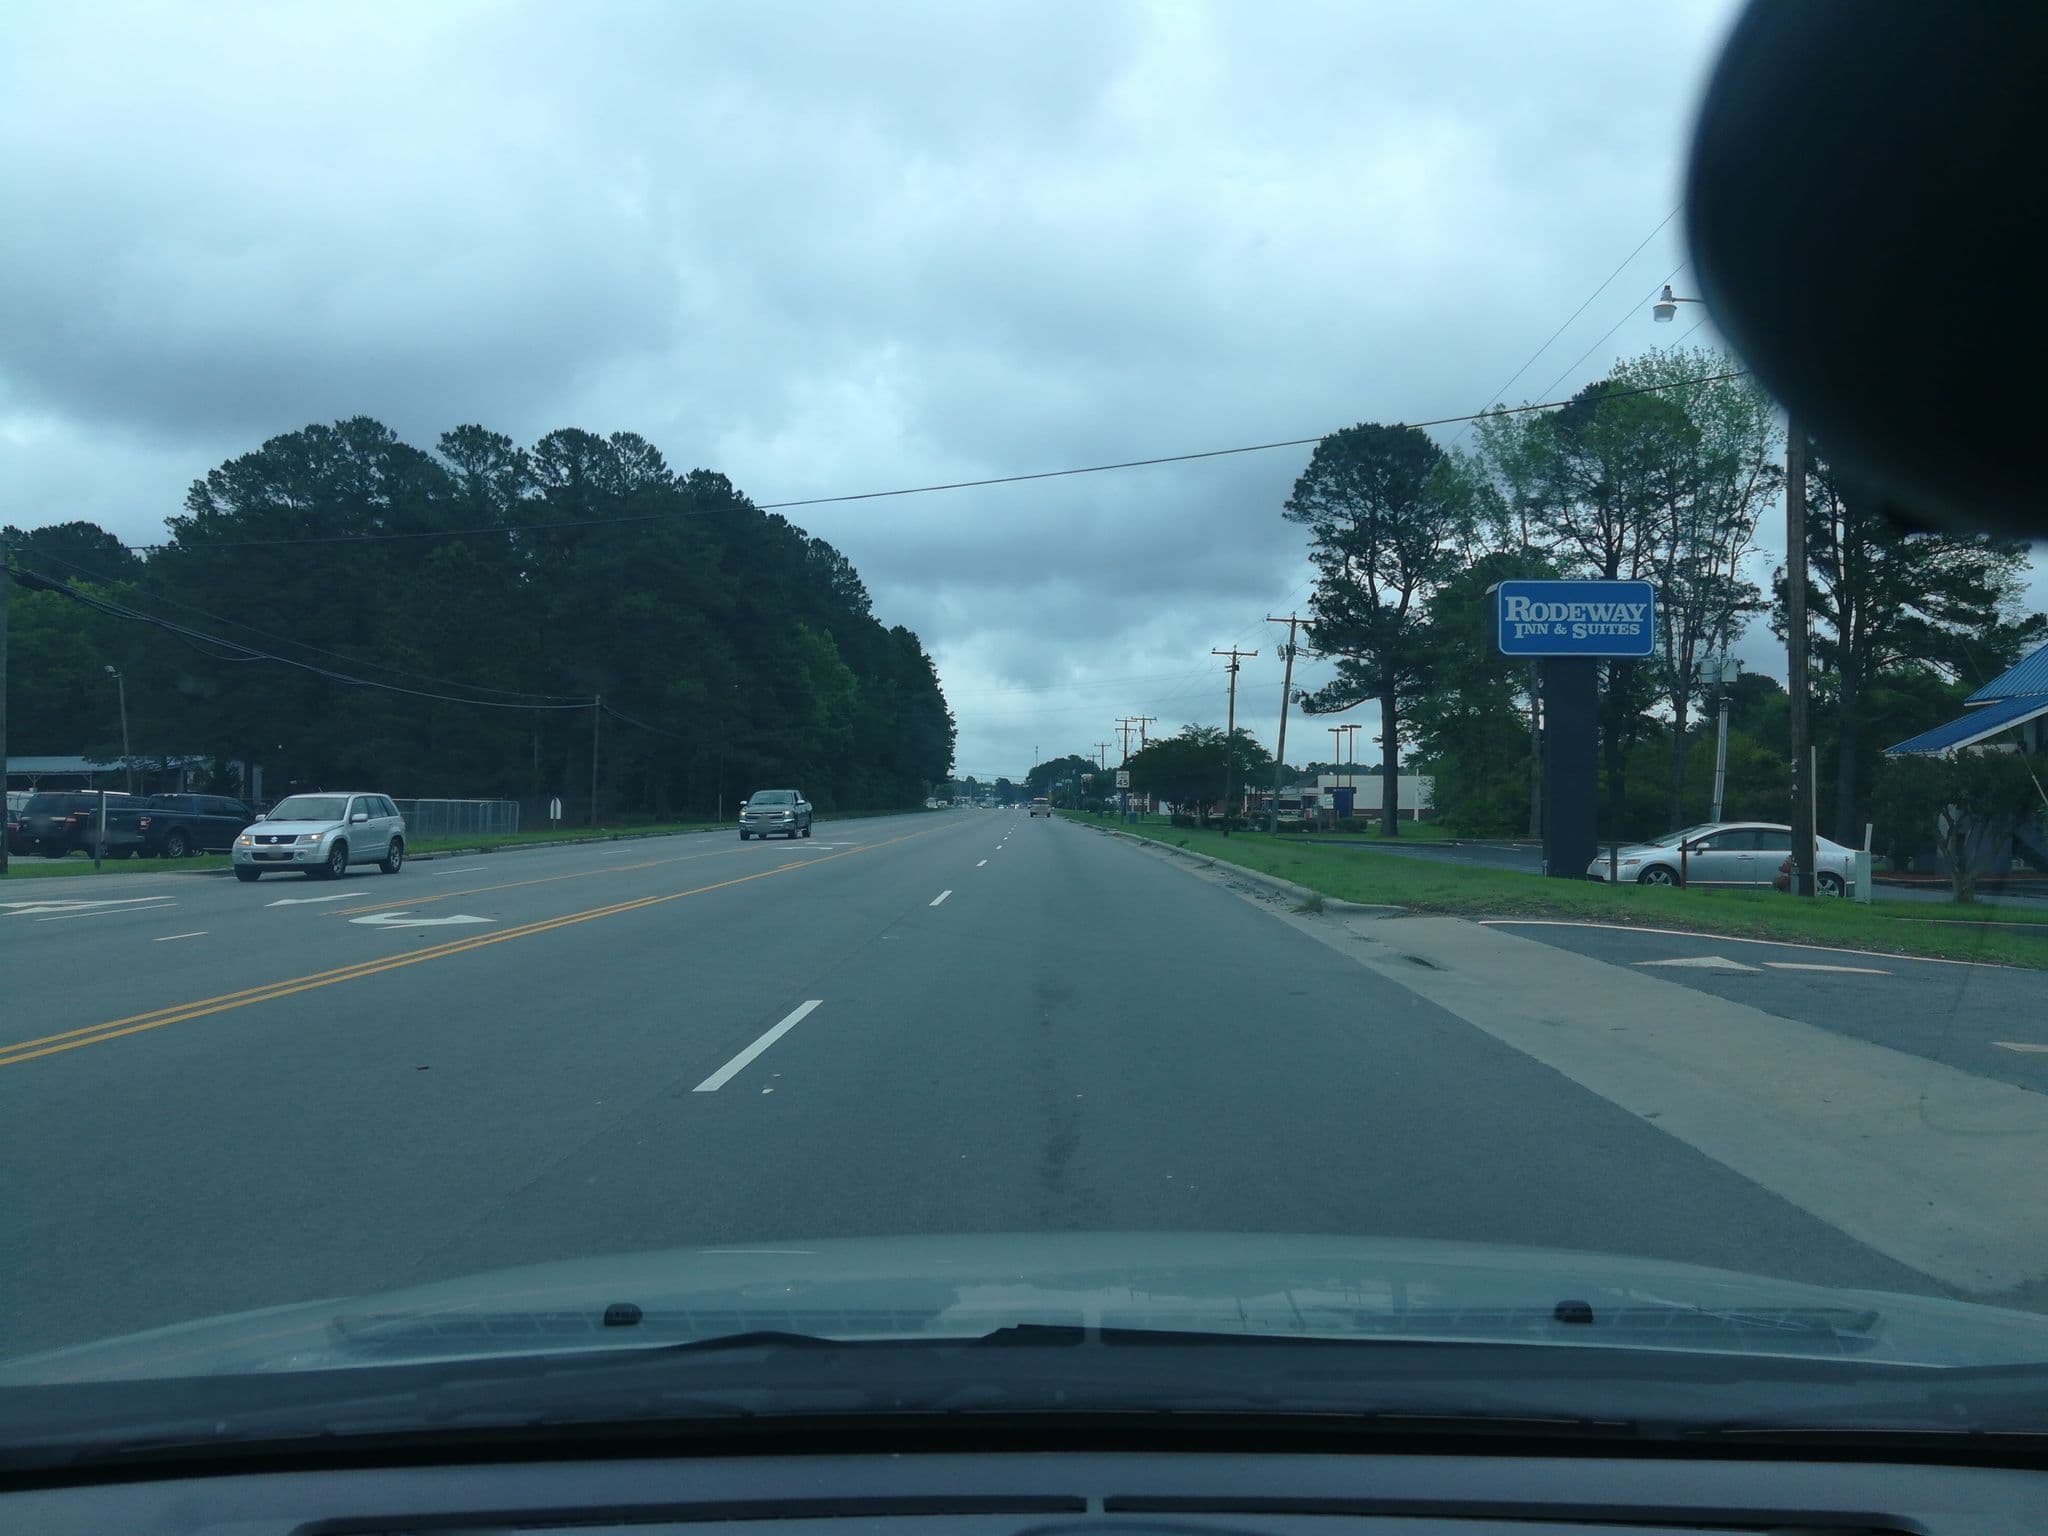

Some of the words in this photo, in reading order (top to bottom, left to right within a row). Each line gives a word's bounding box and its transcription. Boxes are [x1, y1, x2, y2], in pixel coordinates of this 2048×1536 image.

[1504, 596, 1647, 622] RODEWAY
[1514, 623, 1549, 639] INN
[1553, 623, 1568, 635] &
[1572, 623, 1641, 639] SUITES
